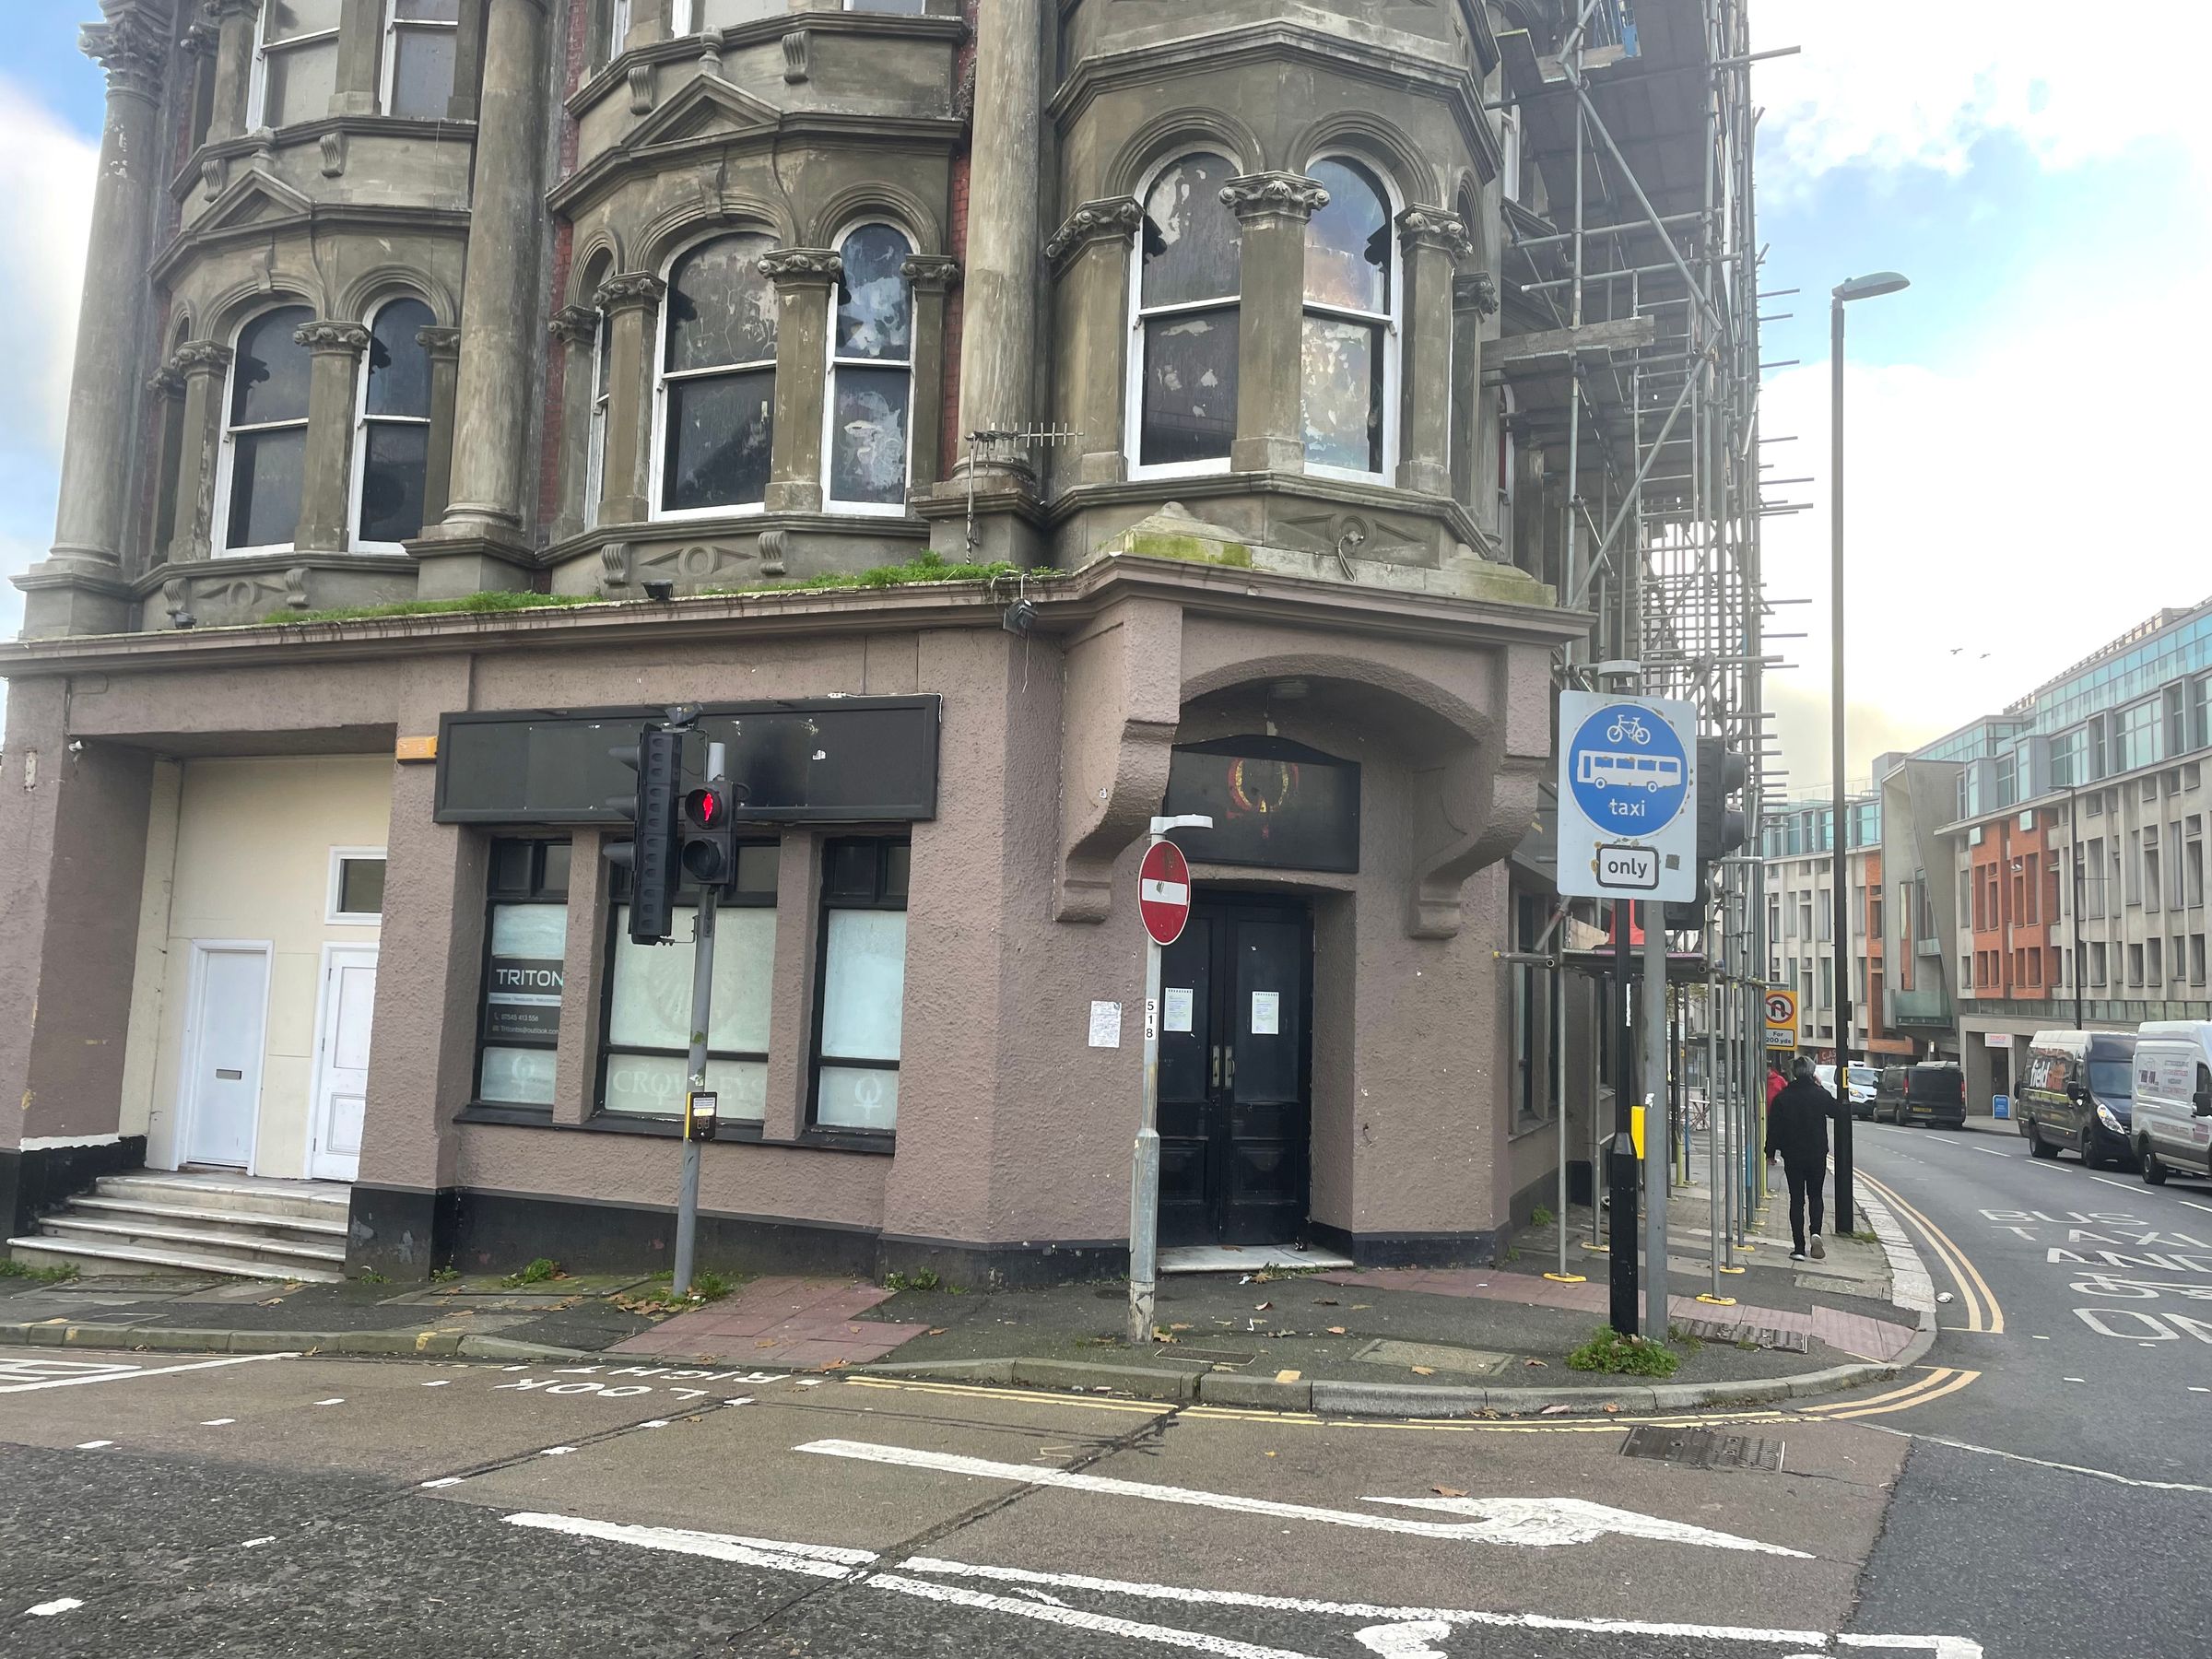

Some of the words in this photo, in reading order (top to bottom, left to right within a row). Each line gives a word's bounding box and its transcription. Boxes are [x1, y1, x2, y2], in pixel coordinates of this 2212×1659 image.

[1609, 798, 1645, 817] taxi
[1607, 858, 1648, 878] only
[496, 969, 564, 987] TRITON
[1978, 1208, 2150, 1226] BUS
[1990, 1225, 2212, 1248] TAXI
[552, 1364, 791, 1383] RIGHT
[494, 1378, 710, 1400] LOOK
